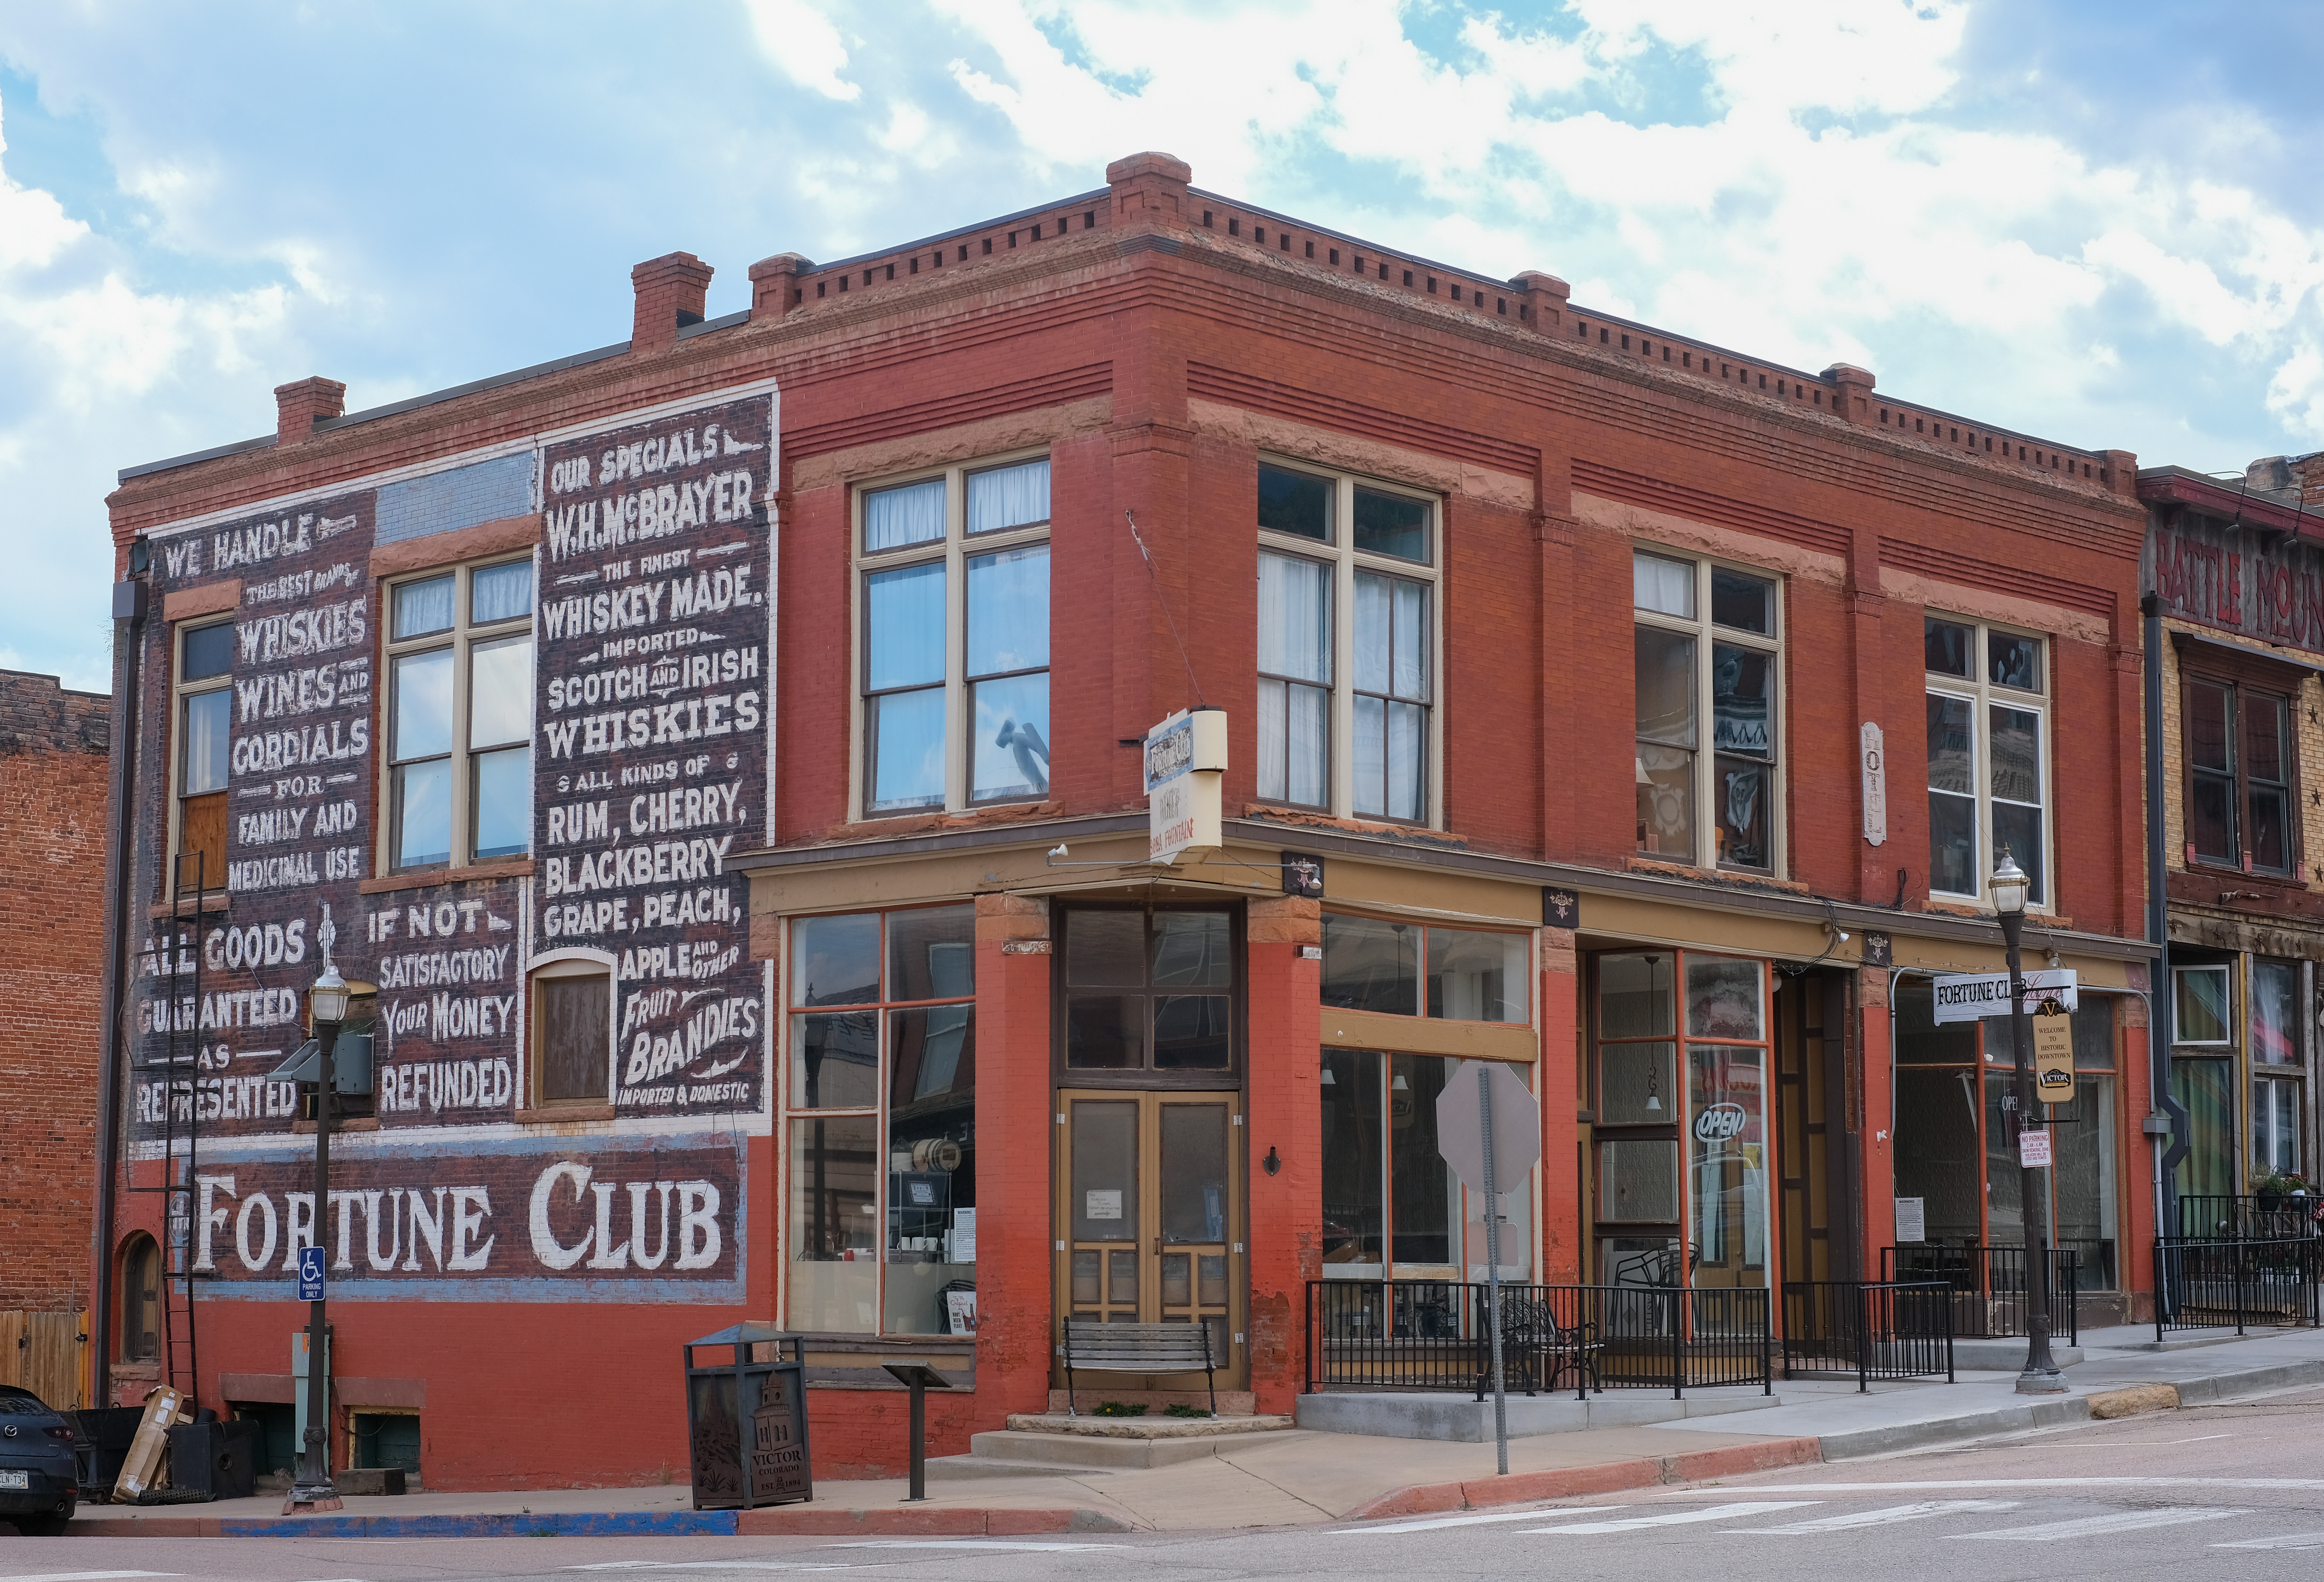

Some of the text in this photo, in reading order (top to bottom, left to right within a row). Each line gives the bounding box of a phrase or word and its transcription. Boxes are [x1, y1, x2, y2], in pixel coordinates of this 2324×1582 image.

[551, 424, 719, 494] OUR SPECIALS
[165, 513, 313, 579] WE HANDLE
[603, 549, 691, 582] THE FINEST
[247, 582, 277, 604] THE
[277, 569, 314, 599] BEST
[345, 569, 360, 586] OF
[2156, 530, 2242, 626] BATTLE
[543, 563, 763, 640] WHISKEY MADE.
[236, 594, 367, 666] WHISKIES
[603, 628, 699, 658] IMPORTED
[235, 662, 370, 723] WINES AND
[548, 646, 759, 712] SCOTCH AND IRISH
[232, 716, 369, 775] CORDIALS
[544, 689, 760, 759] WHISKIES
[275, 775, 325, 799] FOR
[575, 771, 616, 791] ALL
[685, 755, 710, 777] OF
[238, 800, 357, 846] FAMILY AND
[549, 777, 747, 847] RUM, CHERRY,
[1165, 817, 1194, 849] FOUNTAIN
[228, 846, 360, 891] MEDICINAL USE
[546, 833, 734, 898] BLACKBERRY
[368, 898, 485, 943] IF NOT
[544, 887, 740, 937] GRAPE, PEACH,
[138, 918, 306, 977] ALL GOODS
[379, 944, 510, 990] SATISFACTORY
[618, 940, 739, 981] APPLE AND OTHER
[1937, 981, 1994, 1007] FORTUNE
[1996, 978, 2027, 999] CLB
[2043, 1002, 2057, 1016] V
[432, 991, 516, 1042] MONEY
[198, 1045, 229, 1069] AS
[625, 997, 760, 1085] BRANDIES
[380, 1057, 512, 1114] REFUNDED
[618, 1082, 749, 1106] IMPORTED & DOMESTIC
[1699, 1111, 1741, 1136] OPEN
[528, 1161, 722, 1270] CLUB
[753, 1450, 802, 1466] VICTOR
[759, 1464, 799, 1476] COLORADO
[761, 1479, 800, 1490] EST. 1894
